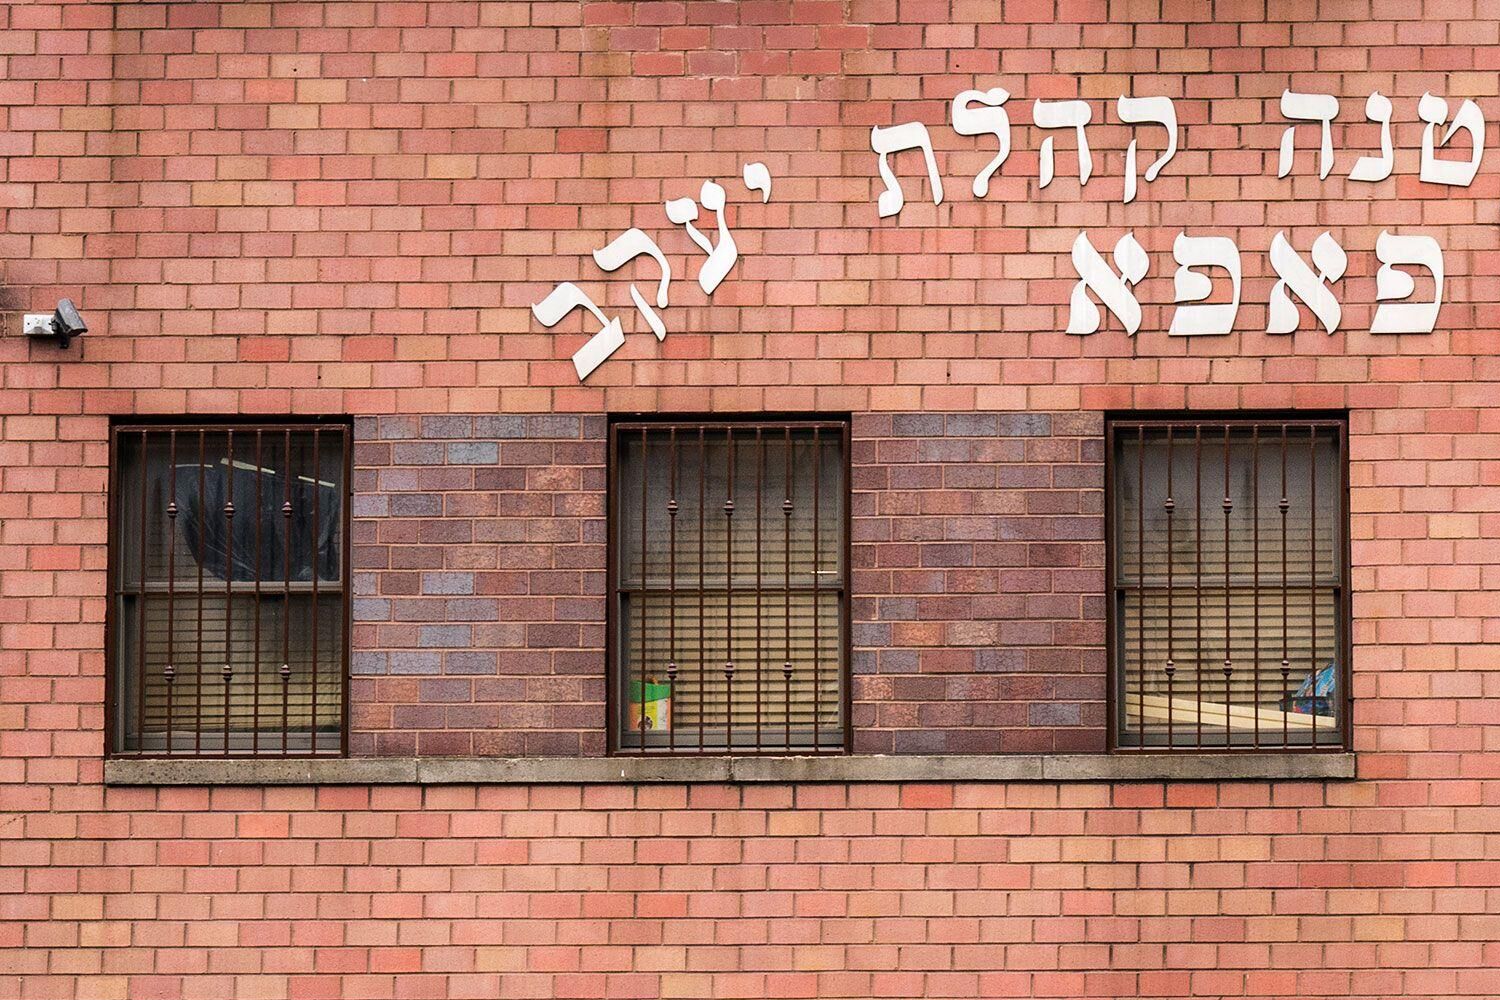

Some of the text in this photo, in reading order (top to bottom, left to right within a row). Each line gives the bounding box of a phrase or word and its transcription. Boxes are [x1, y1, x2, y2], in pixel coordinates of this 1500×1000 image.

[871, 87, 1178, 218] קהלת
[531, 162, 771, 381] יעקב
[1065, 229, 1444, 336] פאפא
